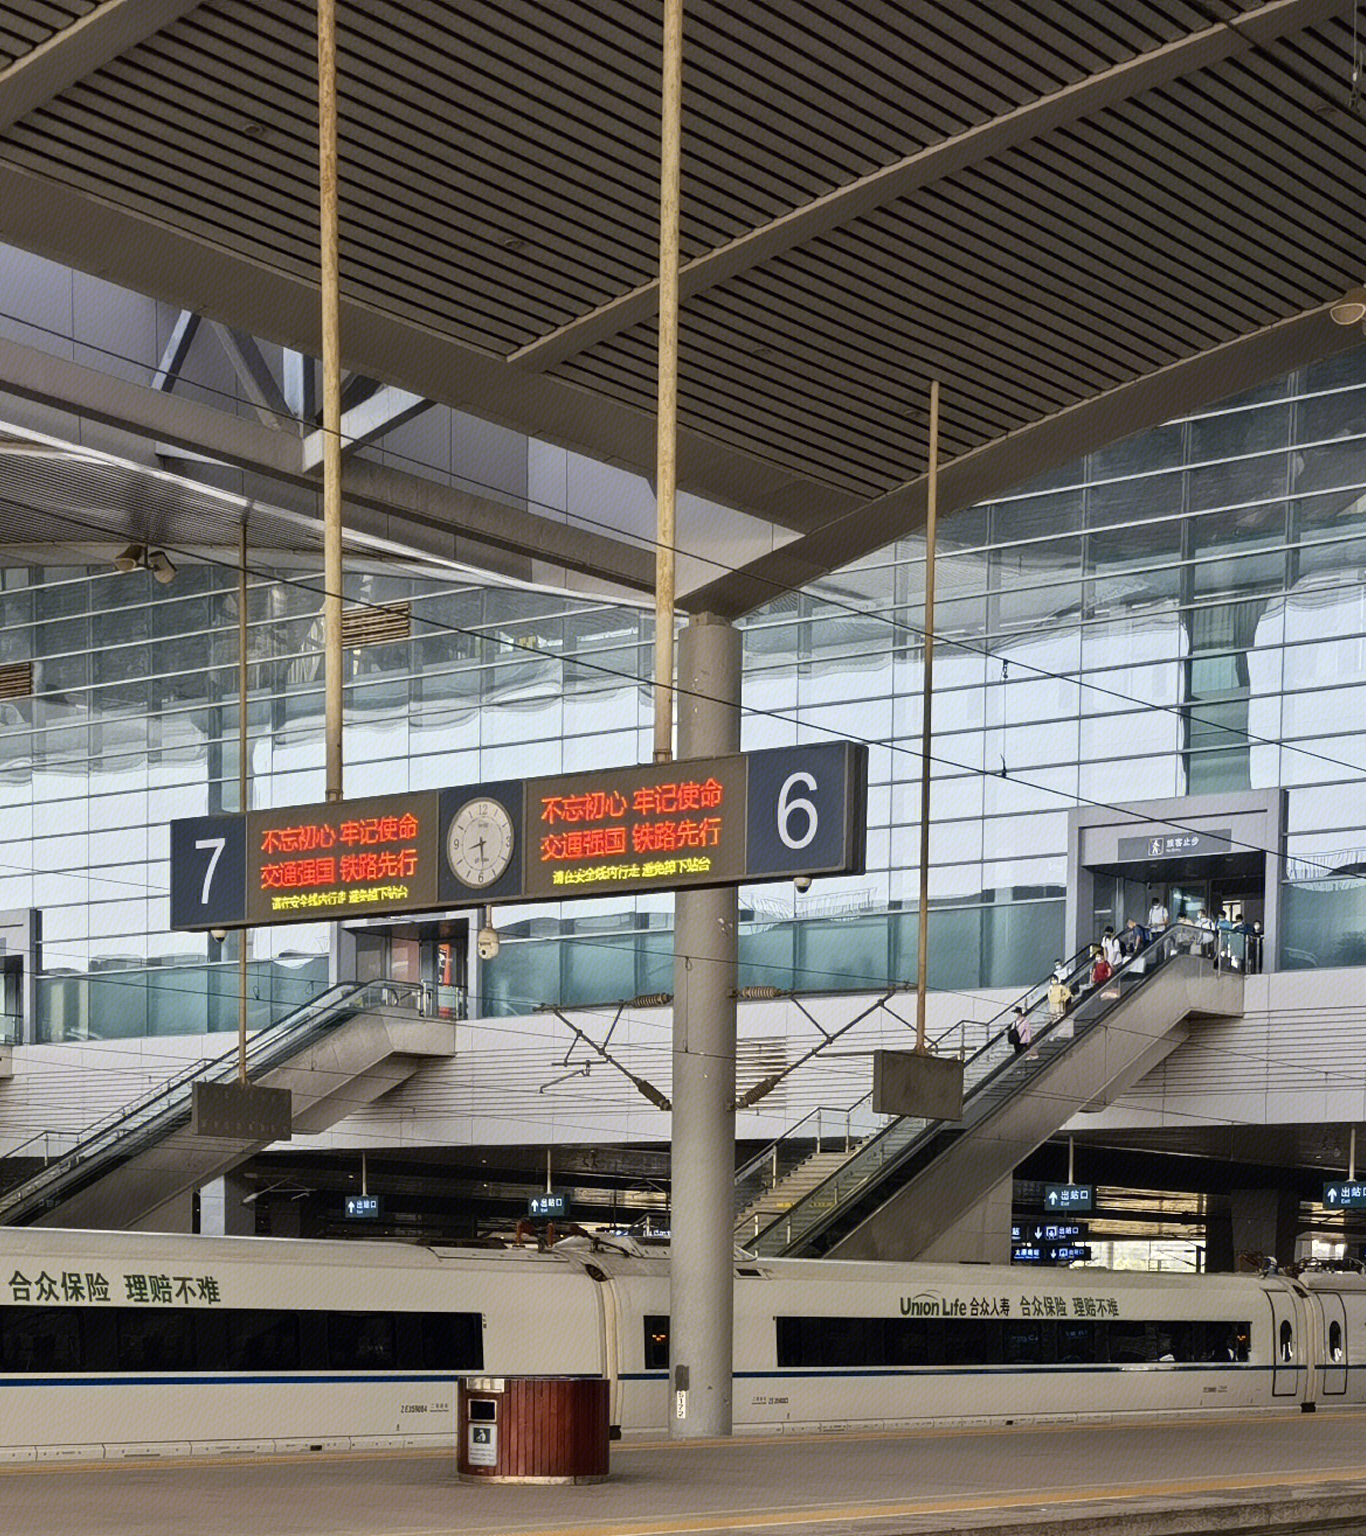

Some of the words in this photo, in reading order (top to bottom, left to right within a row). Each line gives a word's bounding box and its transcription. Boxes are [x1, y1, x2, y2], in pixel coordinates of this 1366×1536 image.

[479, 804, 488, 815] 12
[541, 790, 627, 825] 不忘初心
[632, 777, 723, 816] 牢记使命
[777, 772, 818, 850] 6
[261, 824, 335, 854] 不忘初心
[339, 813, 418, 846] 牢记使命
[454, 839, 460, 850] 9
[541, 827, 627, 862] 交通强国
[632, 818, 723, 853] 铁路先行
[196, 838, 225, 904] 7
[261, 857, 335, 889] 交通强国
[339, 848, 418, 882] 铁路先行
[478, 872, 483, 883] 6
[1061, 1190, 1088, 1200] 出站口
[8, 1270, 111, 1303] 合众保险
[123, 1274, 221, 1305] 理赔不难
[900, 1296, 939, 1316] Union
[942, 1298, 967, 1316] Life
[969, 1297, 1010, 1317] 合众人寿
[1020, 1296, 1068, 1317] 合众保险
[1072, 1297, 1120, 1318] 理赔不难
